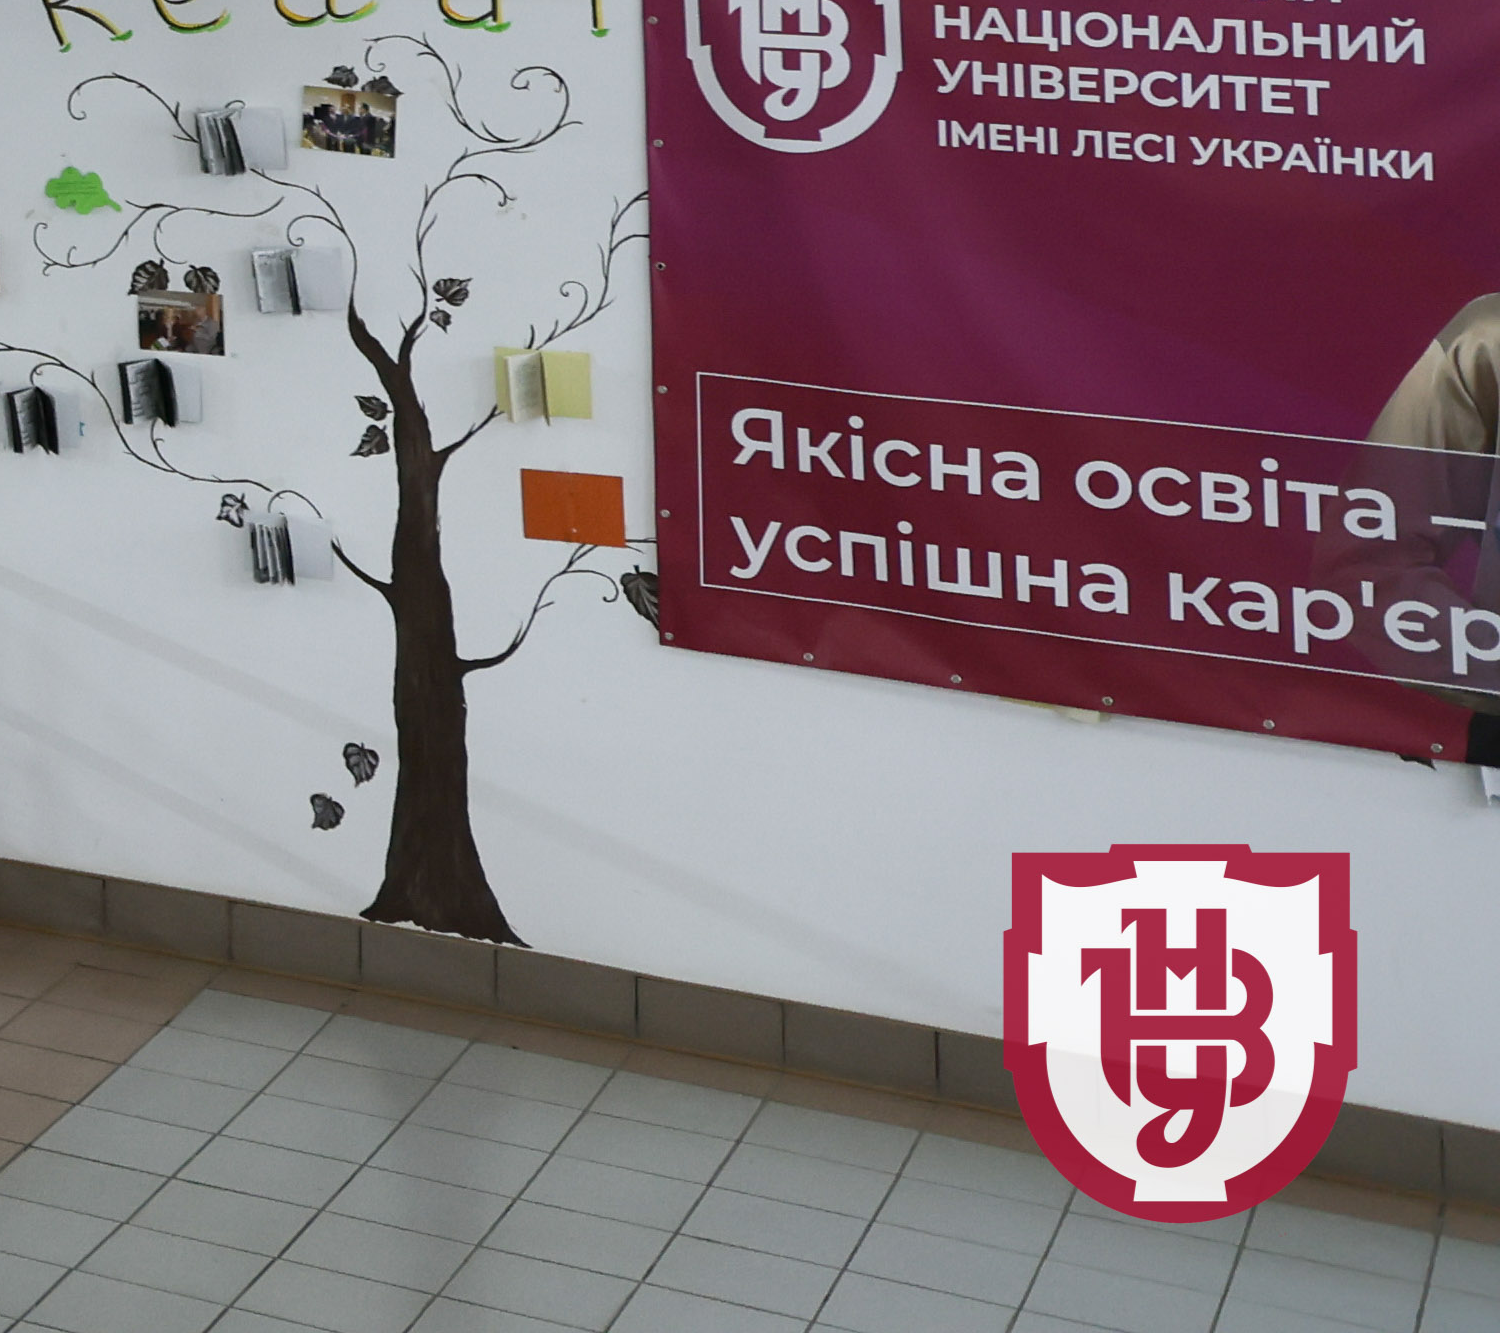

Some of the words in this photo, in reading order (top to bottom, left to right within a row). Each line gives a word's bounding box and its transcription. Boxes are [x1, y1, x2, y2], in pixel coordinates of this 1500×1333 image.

[933, 4, 1426, 65] НАЦІОНАЛЬНИЙ
[933, 58, 1330, 116] УНІВЕРСИТЕТ
[937, 119, 1059, 156] ІМЕНІ
[1072, 129, 1175, 164] ЛЕСІ
[1189, 136, 1434, 181] УКРАЇНКИ
[730, 408, 1041, 502] Якісна
[1074, 457, 1397, 541] освіта
[729, 516, 1129, 615] успішна
